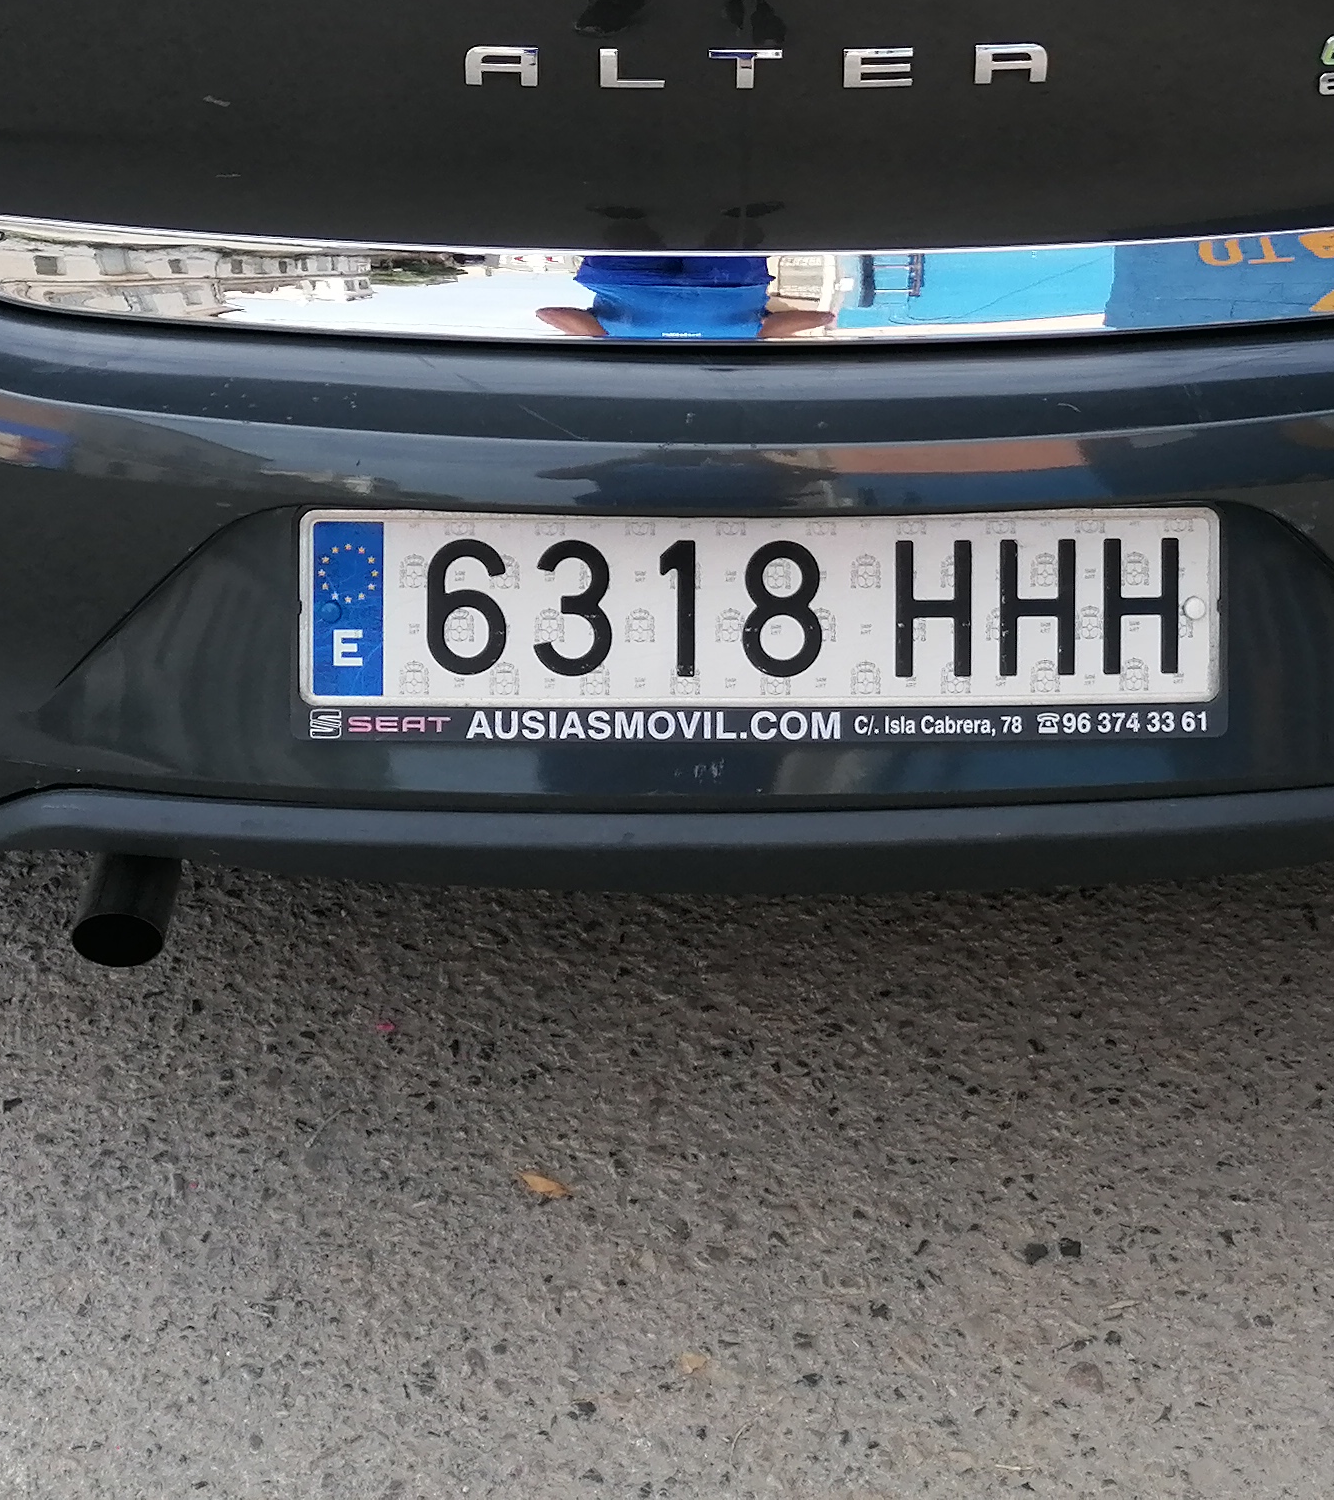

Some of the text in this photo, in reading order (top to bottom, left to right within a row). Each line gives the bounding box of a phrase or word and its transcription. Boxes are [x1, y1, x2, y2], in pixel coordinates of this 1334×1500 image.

[465, 43, 1048, 88] ALTEA
[425, 537, 1180, 678] 6318 HHH
[331, 629, 364, 668] E
[347, 715, 451, 733] SEAT
[466, 710, 842, 740] AUSIASMOVIL.COM
[884, 714, 916, 735] Isla
[920, 713, 996, 737] Cabrera,
[1000, 714, 1023, 734] 78
[1062, 712, 1092, 733] 96
[1097, 711, 1140, 733] 374
[1146, 711, 1175, 732] 33
[1181, 710, 1208, 732] 61
